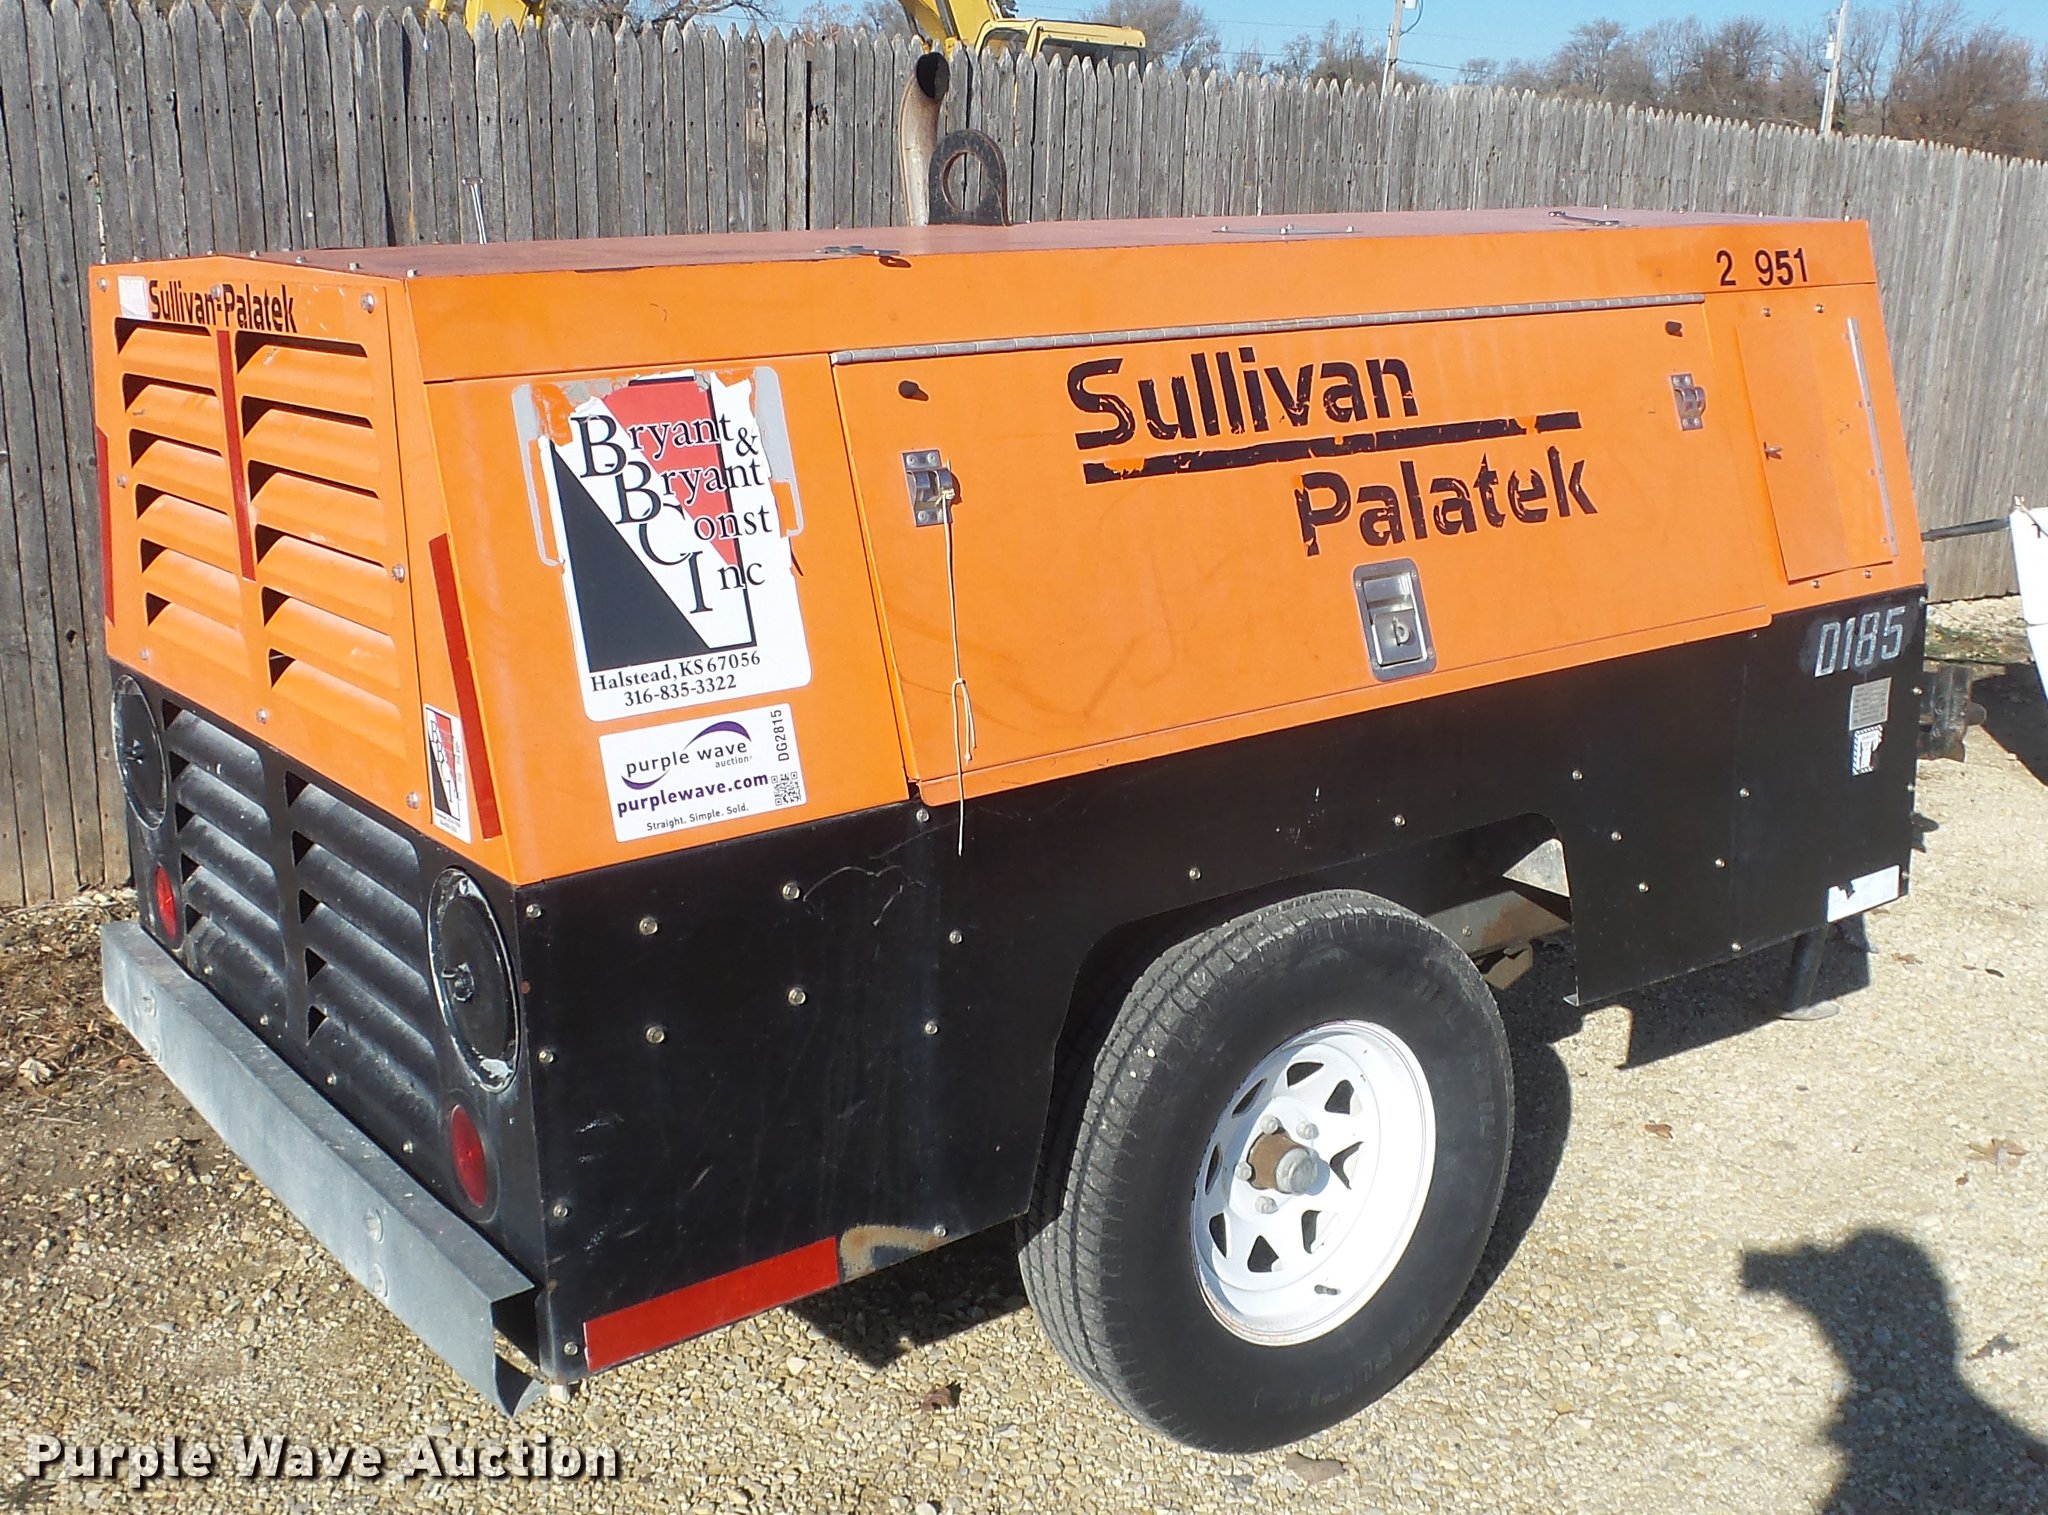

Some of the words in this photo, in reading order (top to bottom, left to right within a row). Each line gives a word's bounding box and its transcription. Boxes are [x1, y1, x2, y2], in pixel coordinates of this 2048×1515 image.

[1716, 250, 1737, 286] 2
[1755, 248, 1808, 286] 951
[1067, 346, 1419, 449] Sullivan
[570, 412, 734, 478] Bryant
[604, 458, 765, 524] Bryant
[1294, 446, 1598, 557] Palatek
[638, 502, 773, 566] Const
[689, 550, 766, 614] Inc
[591, 663, 678, 693] Halstead,
[679, 658, 704, 679] KS
[706, 650, 761, 673] 67056
[624, 674, 737, 707] 316-835-3322
[626, 750, 690, 778] purple
[697, 741, 748, 761] wave
[770, 709, 790, 762] DG2815
[715, 755, 750, 769] auction
[617, 772, 769, 818] purplewave.com
[646, 816, 687, 831] Straight.
[689, 808, 725, 824] Simple.
[726, 803, 750, 815] Sold.
